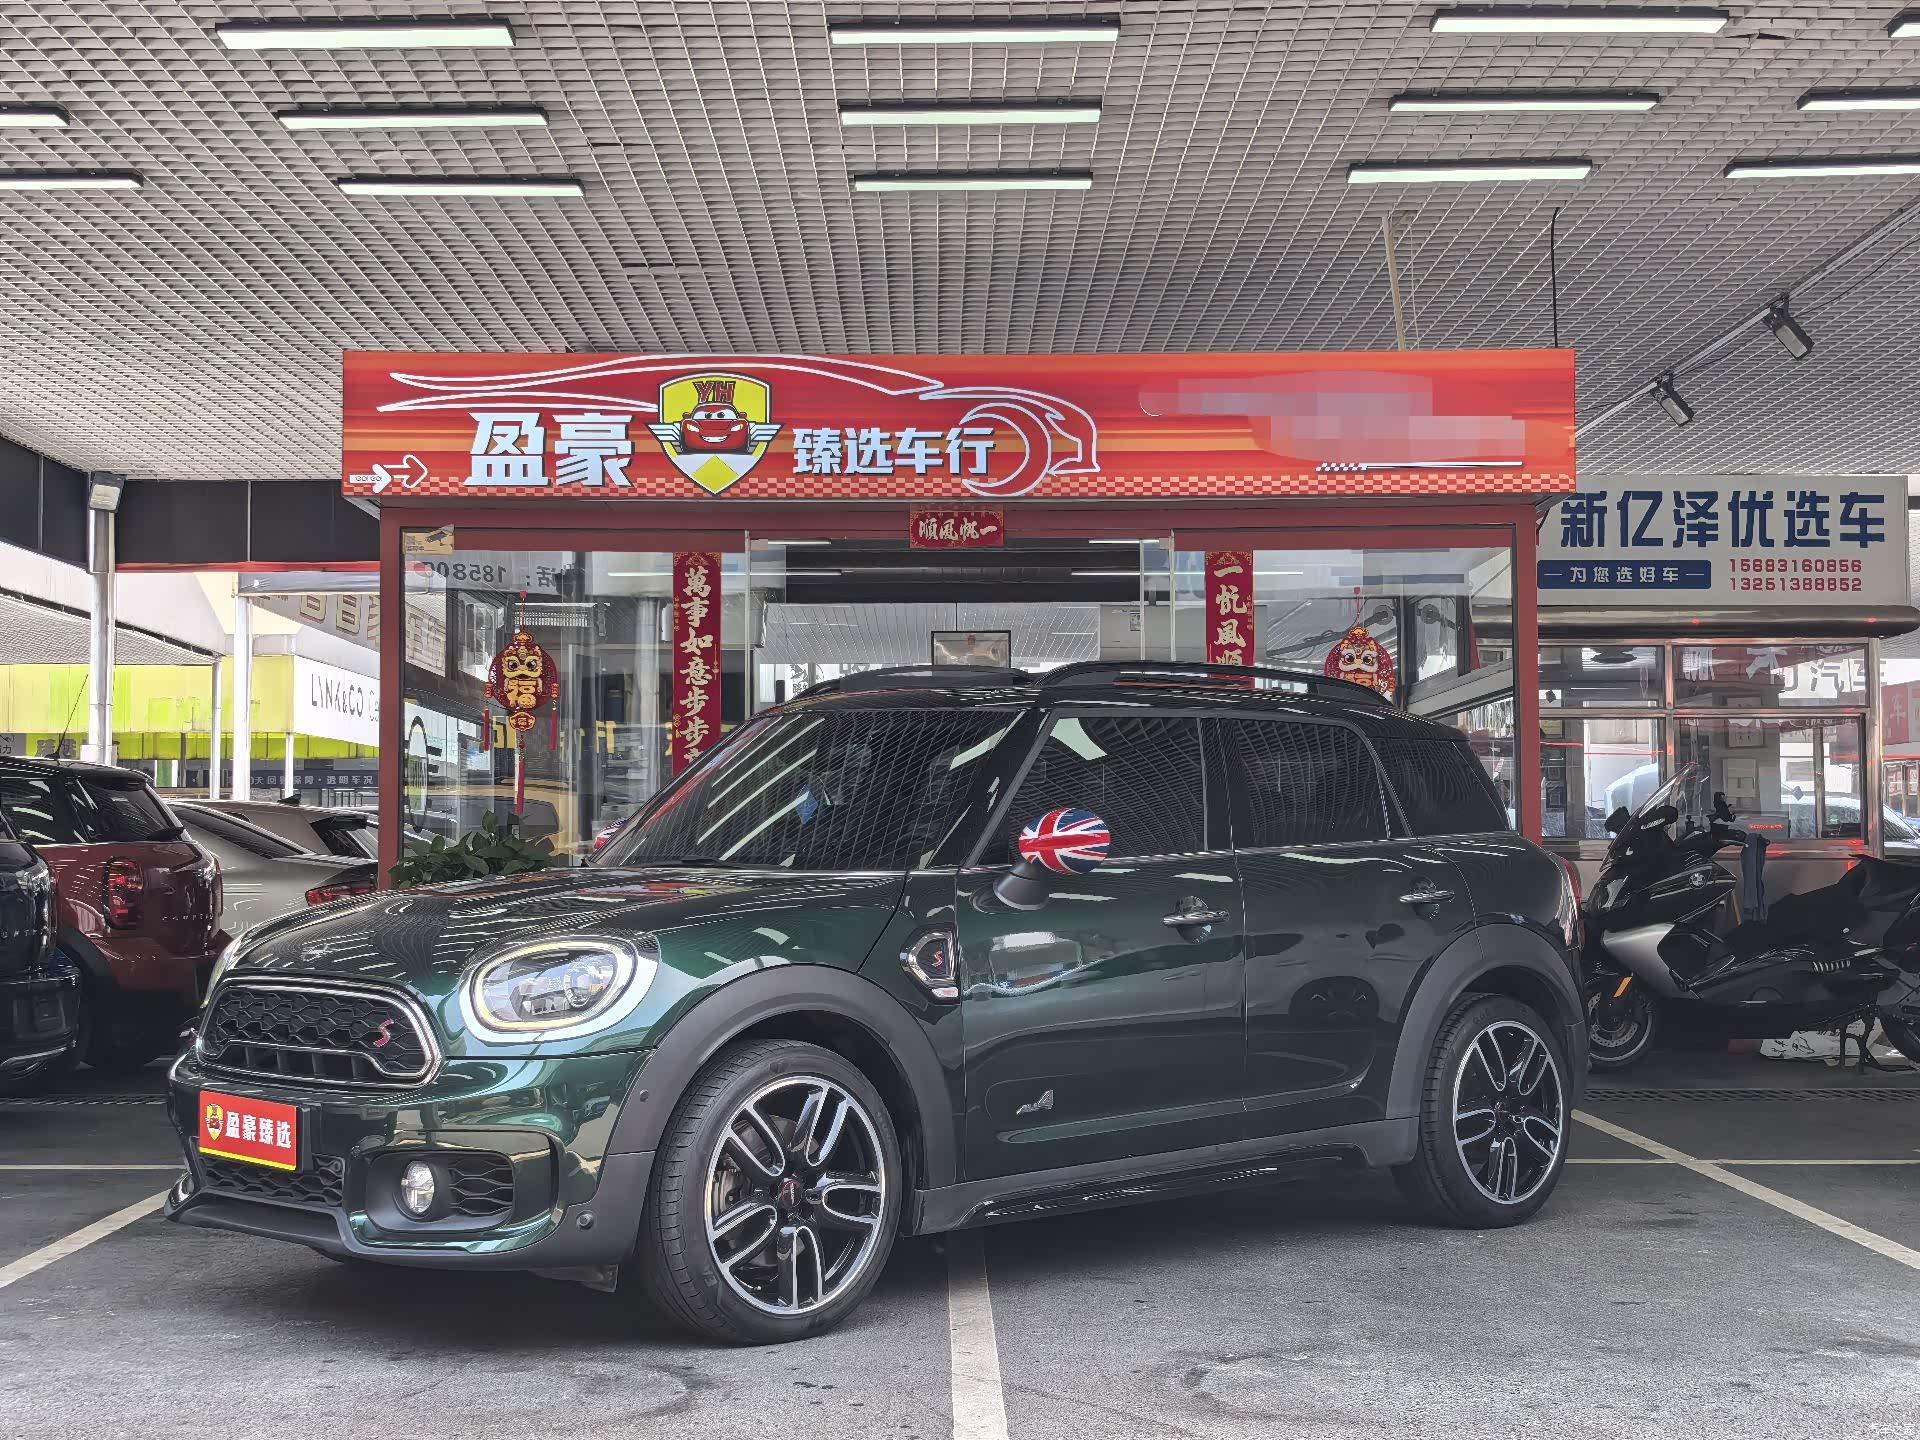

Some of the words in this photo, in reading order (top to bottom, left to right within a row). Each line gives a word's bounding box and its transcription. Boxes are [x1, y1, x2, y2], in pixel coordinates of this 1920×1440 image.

[692, 381, 736, 404] YH
[464, 411, 634, 487] 盈豪
[791, 426, 995, 476] 臻选车行
[1560, 490, 1886, 549] 新亿泽优选车
[1569, 566, 1680, 584] 为您选好车
[1729, 577, 1862, 592] 13251388852
[373, 1019, 394, 1048] S
[225, 1111, 292, 1149] 盈豪臻选
